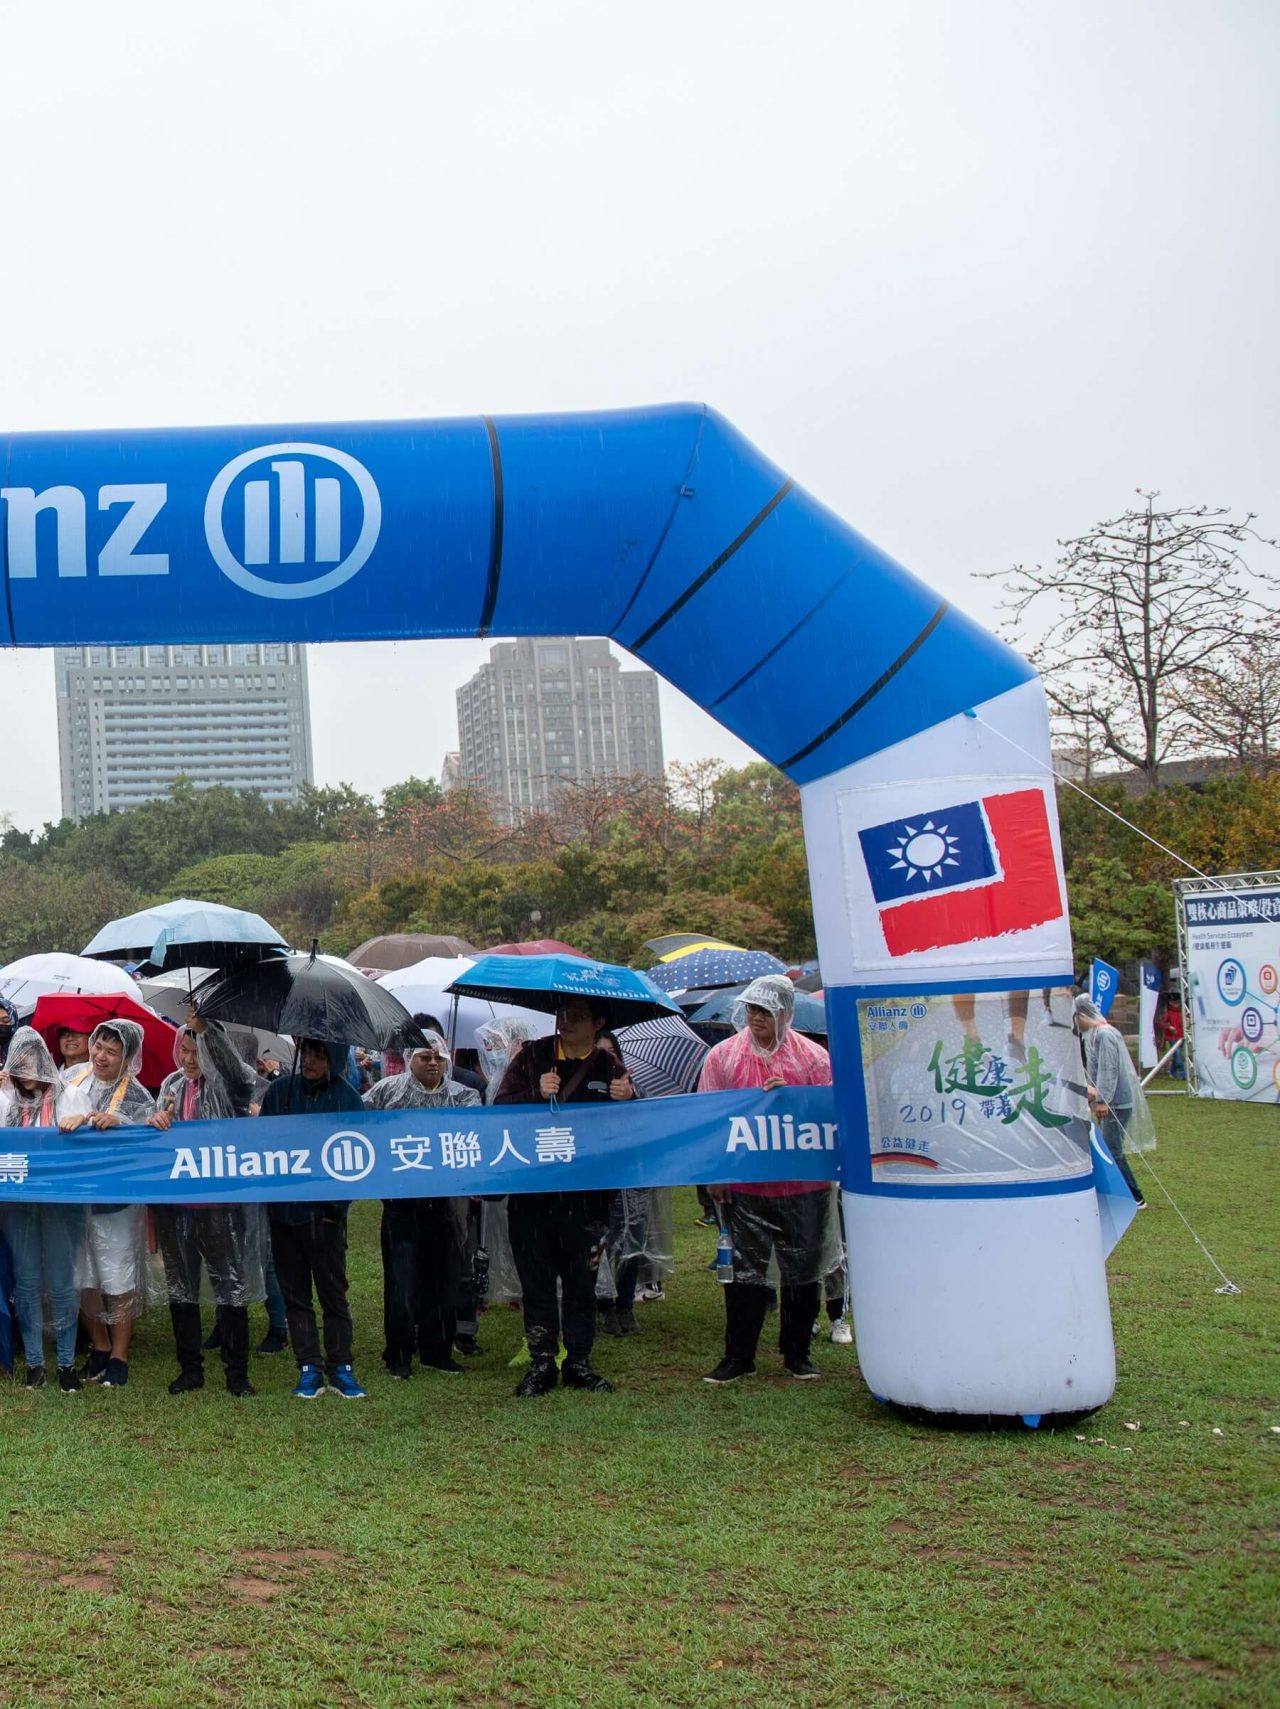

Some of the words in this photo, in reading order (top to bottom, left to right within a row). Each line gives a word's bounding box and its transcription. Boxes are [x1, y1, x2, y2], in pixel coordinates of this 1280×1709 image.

[867, 1006, 907, 1018] Allianz
[900, 1098, 967, 1125] 2019
[169, 1144, 312, 1179] Allianz
[390, 1125, 578, 1172] 安聯人壽
[880, 1136, 931, 1153] 公益健走
